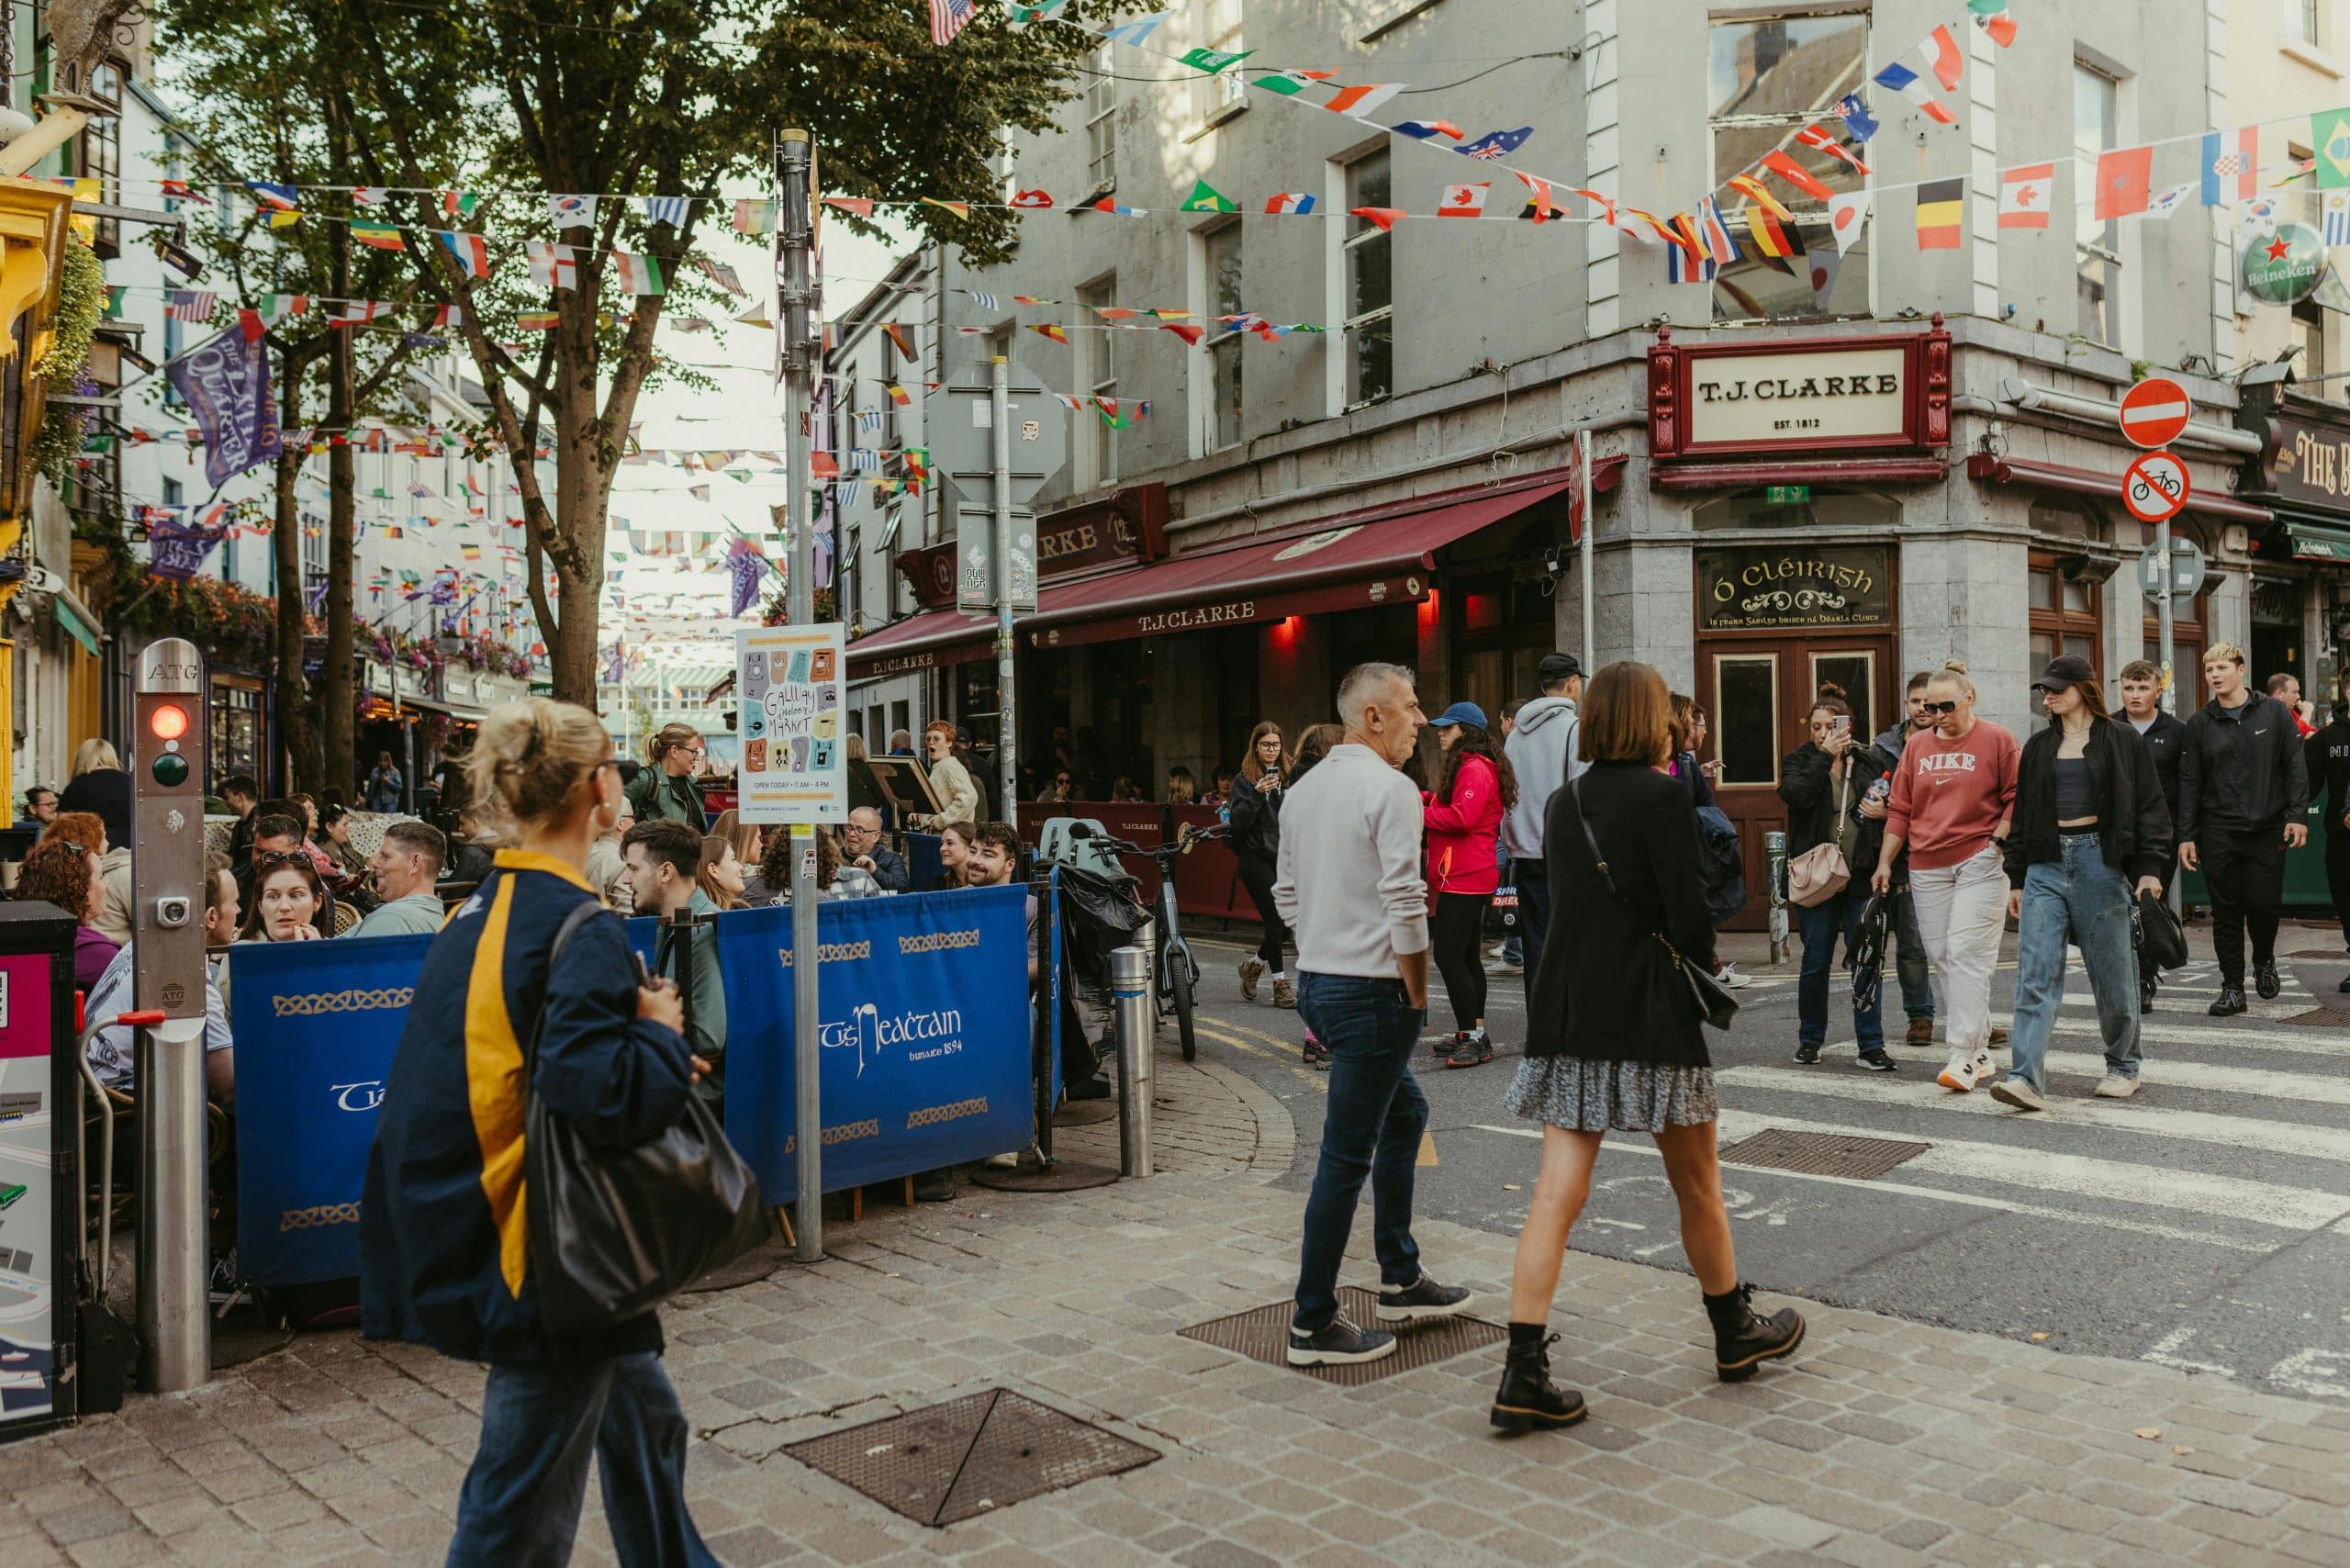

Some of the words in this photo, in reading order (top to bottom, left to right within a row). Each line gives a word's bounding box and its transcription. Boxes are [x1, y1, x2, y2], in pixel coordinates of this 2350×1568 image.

[2248, 264, 2317, 287] Heineken
[1774, 420, 1793, 430] EST.
[1796, 419, 1820, 429] 1812
[2296, 430, 2337, 496] THE
[1036, 524, 1098, 561] RKE
[1714, 577, 1735, 602] Ó
[148, 665, 198, 679] ATG
[1918, 753, 1975, 776] NIKE
[162, 991, 184, 1001] ATG
[944, 1039, 962, 1056] 1894
